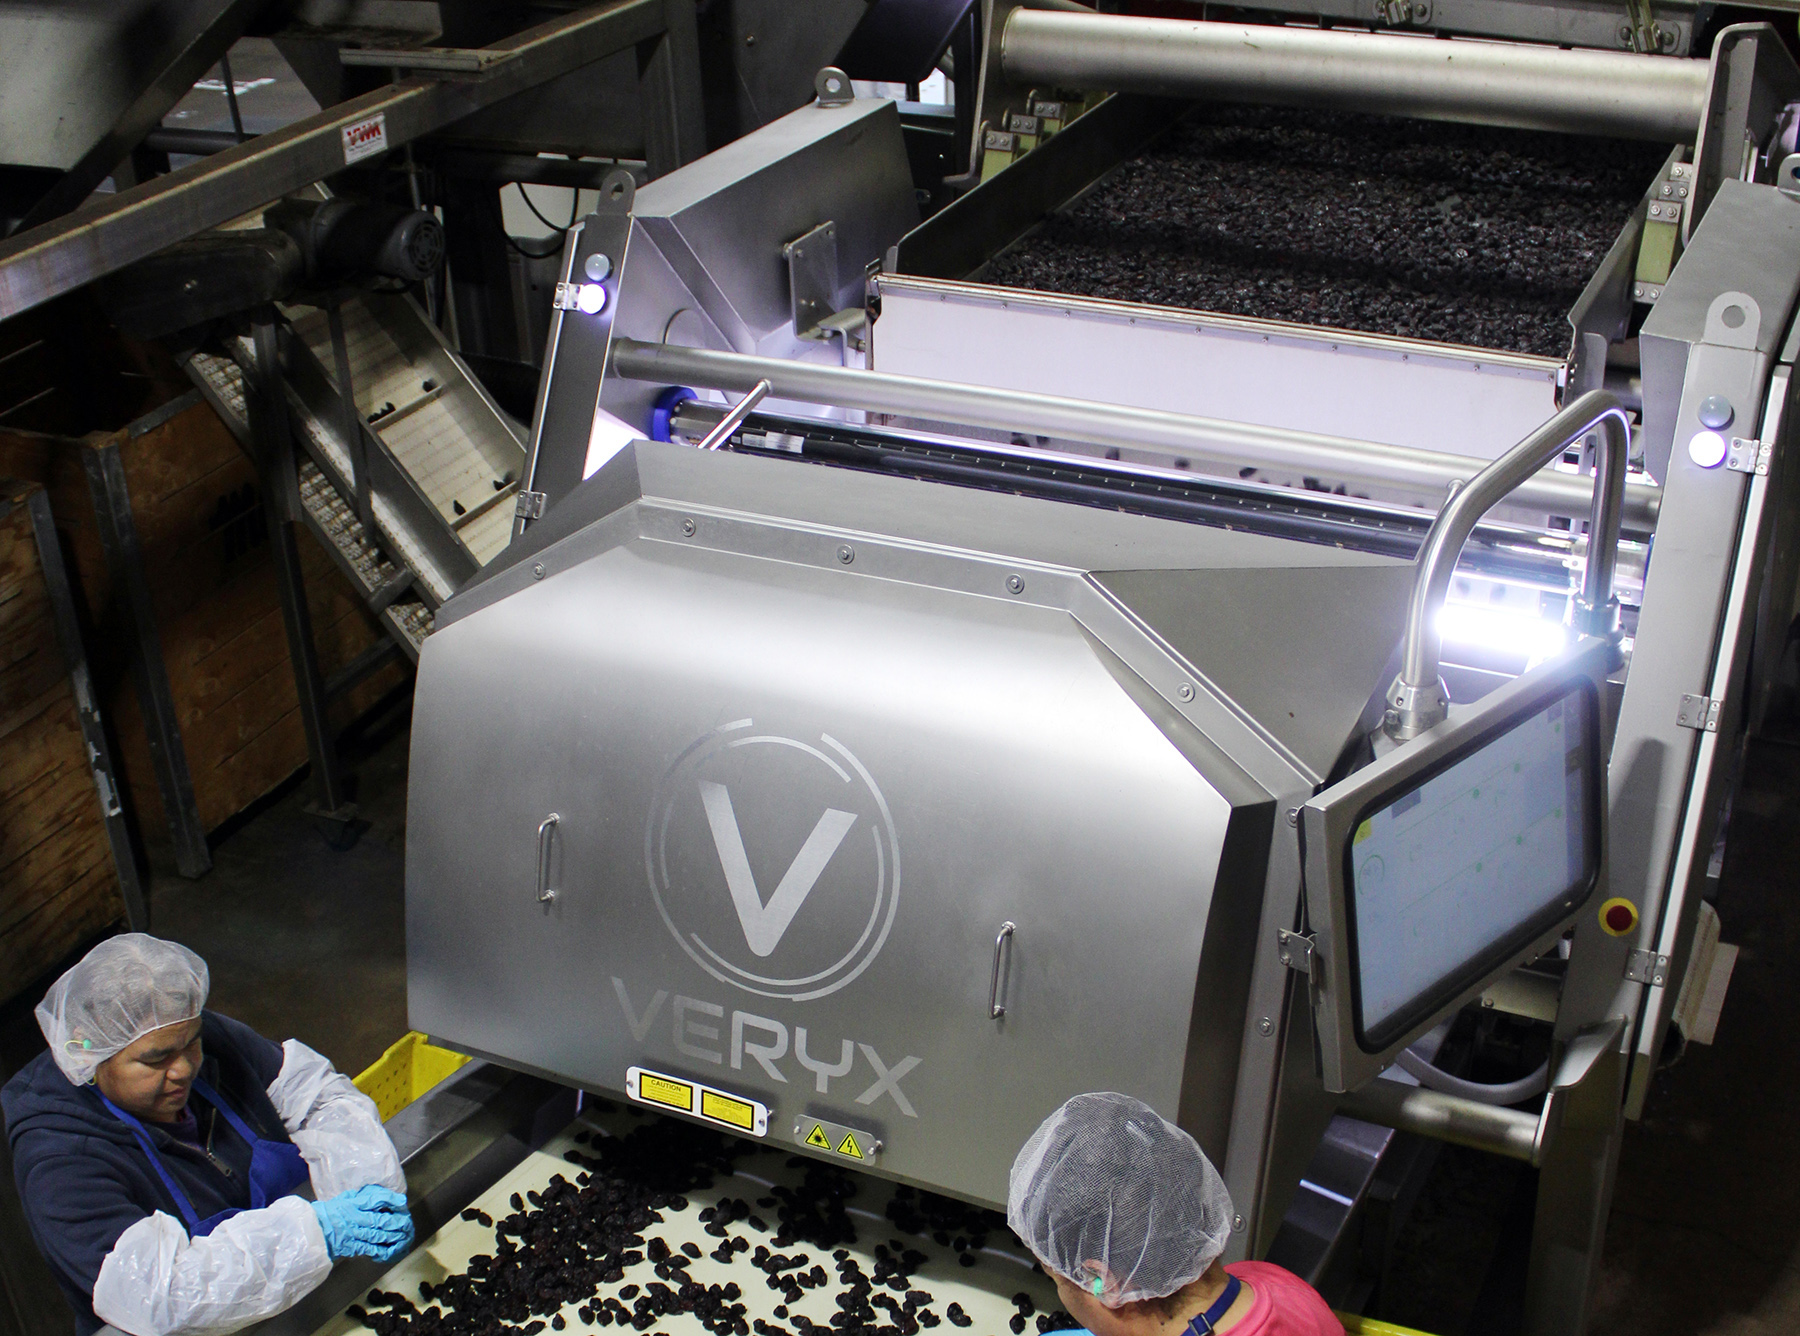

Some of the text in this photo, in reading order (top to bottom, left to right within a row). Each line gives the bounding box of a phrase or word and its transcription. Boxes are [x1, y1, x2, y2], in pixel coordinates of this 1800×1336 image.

[700, 780, 858, 957] V
[611, 976, 923, 1118] VERYX
[651, 1079, 682, 1092] CAUTION
